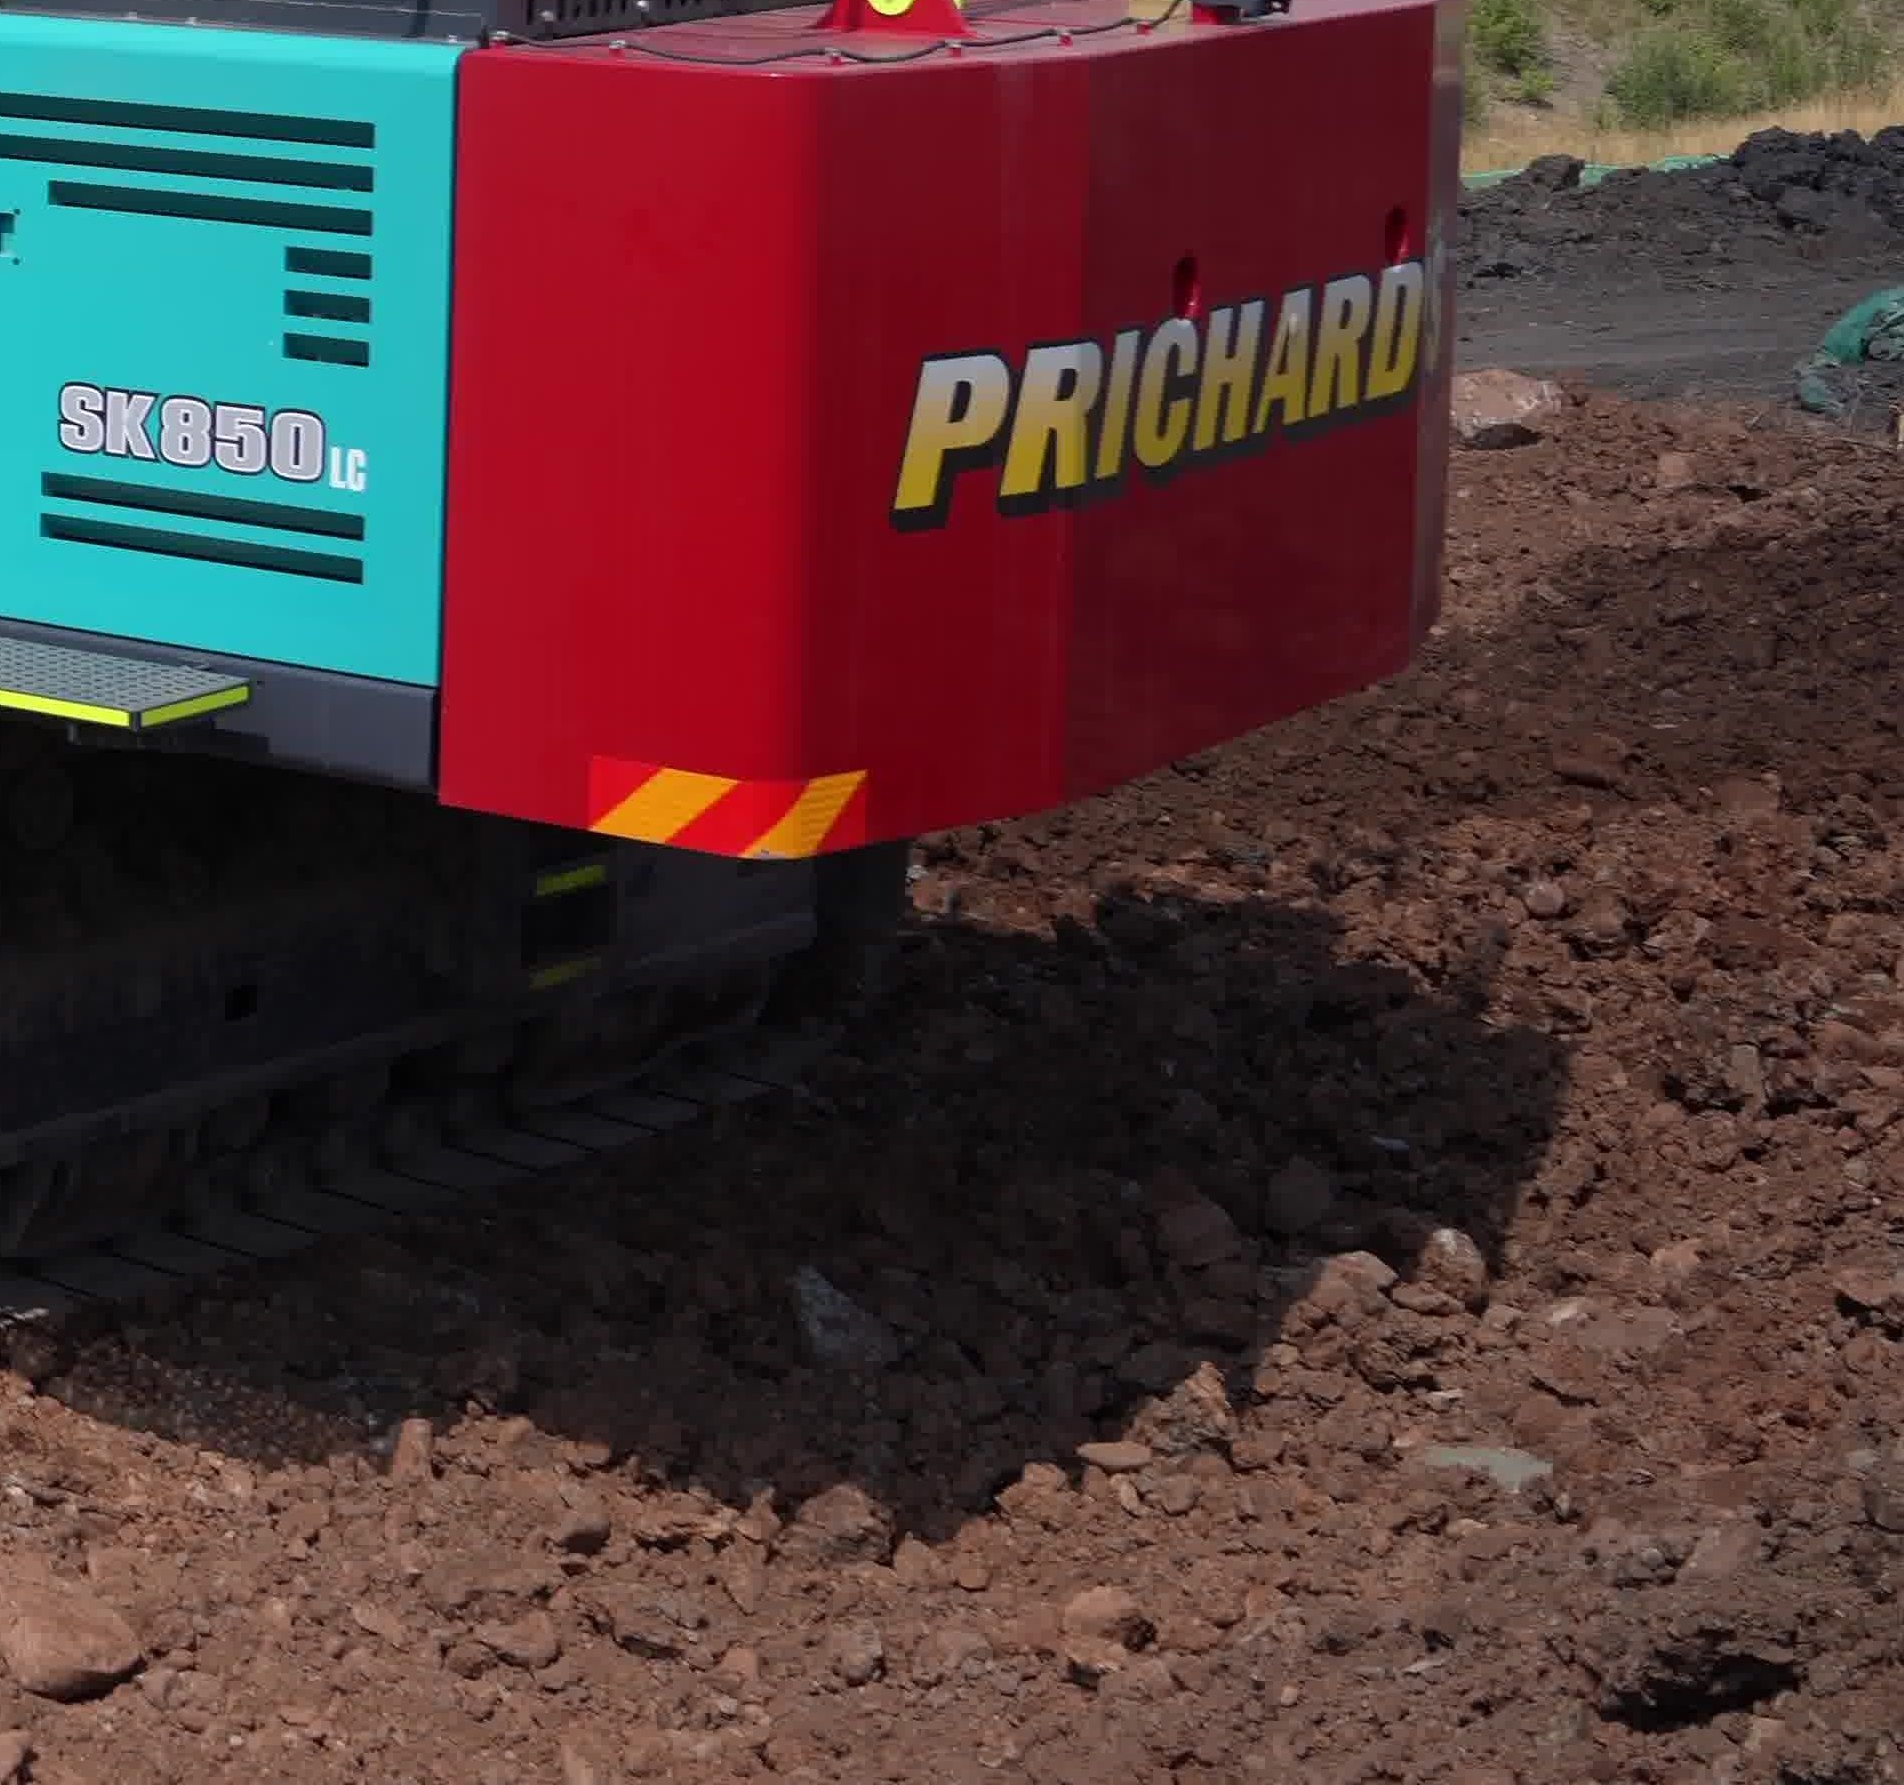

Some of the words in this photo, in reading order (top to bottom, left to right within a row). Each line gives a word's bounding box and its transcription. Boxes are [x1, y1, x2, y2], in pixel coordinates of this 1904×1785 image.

[58, 382, 326, 483] SK850
[329, 447, 368, 492] LC
[890, 256, 1441, 529] PRICHARD
